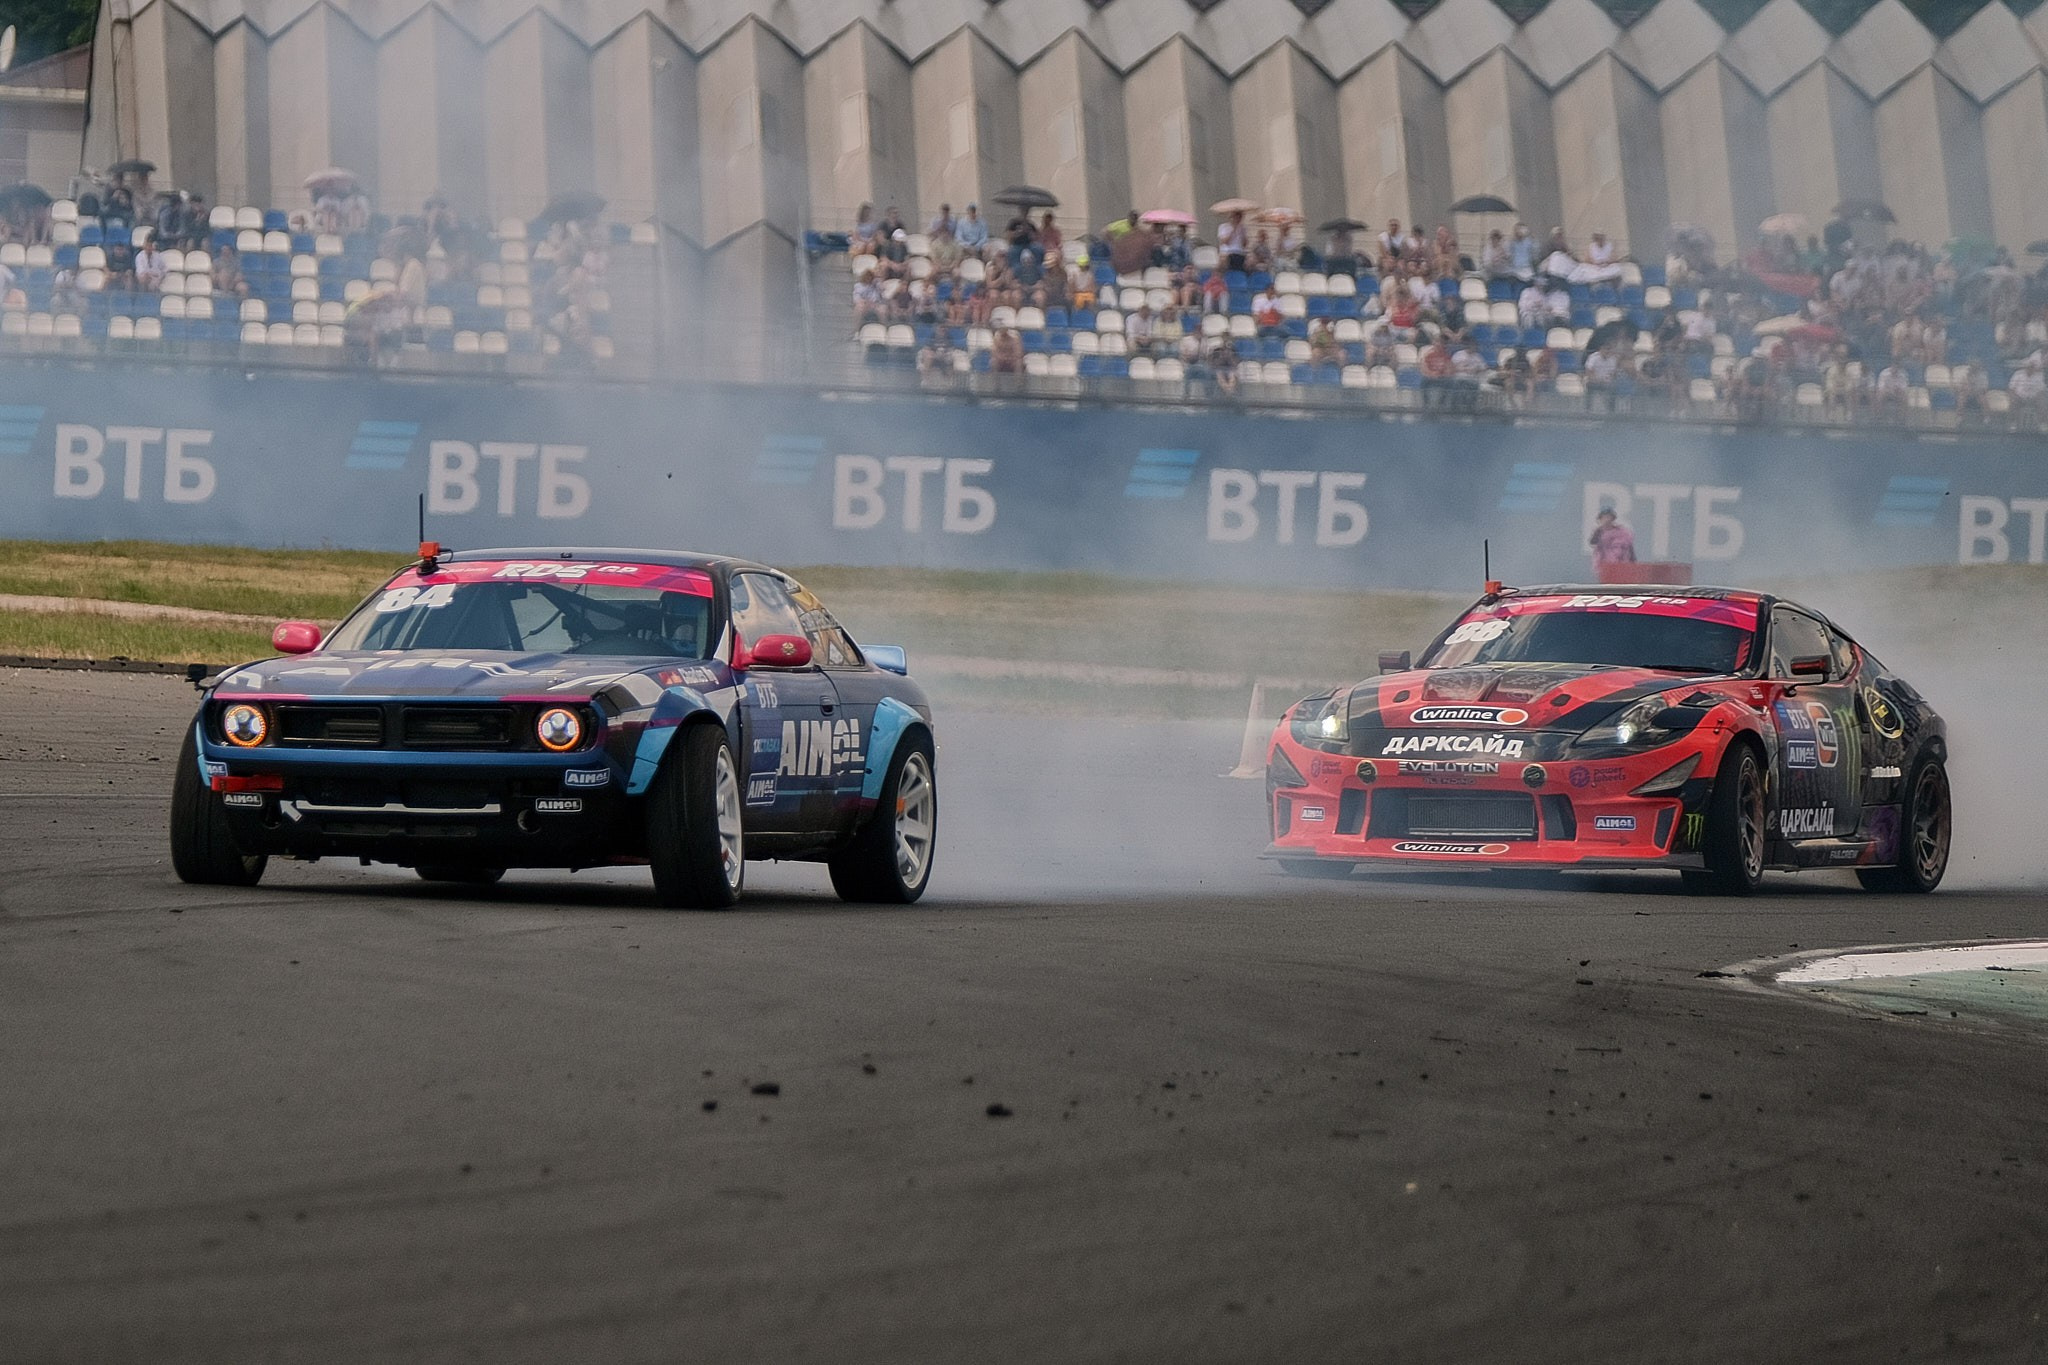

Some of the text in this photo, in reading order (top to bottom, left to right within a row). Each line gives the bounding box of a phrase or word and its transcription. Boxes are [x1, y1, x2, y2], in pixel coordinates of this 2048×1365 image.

[53, 423, 217, 503] ВТБ
[427, 440, 591, 519] ВТБ
[833, 454, 997, 534] ВТБ
[1206, 467, 1370, 547] ВТБ
[491, 563, 600, 578] RDS
[375, 583, 456, 612] 84
[1562, 595, 1653, 608] RDS
[1444, 619, 1510, 645] 88
[755, 683, 778, 708] ВТБ
[1421, 709, 1494, 720] Winline
[1786, 709, 1811, 729] ВТБ
[776, 718, 865, 776] AIMOL
[1382, 734, 1524, 758] ДАРКСАЙД
[1398, 761, 1499, 773] EVOLUTION
[1593, 767, 1624, 776] power
[567, 772, 608, 783] AIMOL
[1593, 773, 1627, 783] wheels
[225, 794, 260, 803] AIMOL
[538, 801, 579, 810] AIMOL
[1596, 818, 1634, 828] AIMOL
[1780, 801, 1835, 838] ДАРКСАЙД
[1403, 843, 1475, 853] Winline
